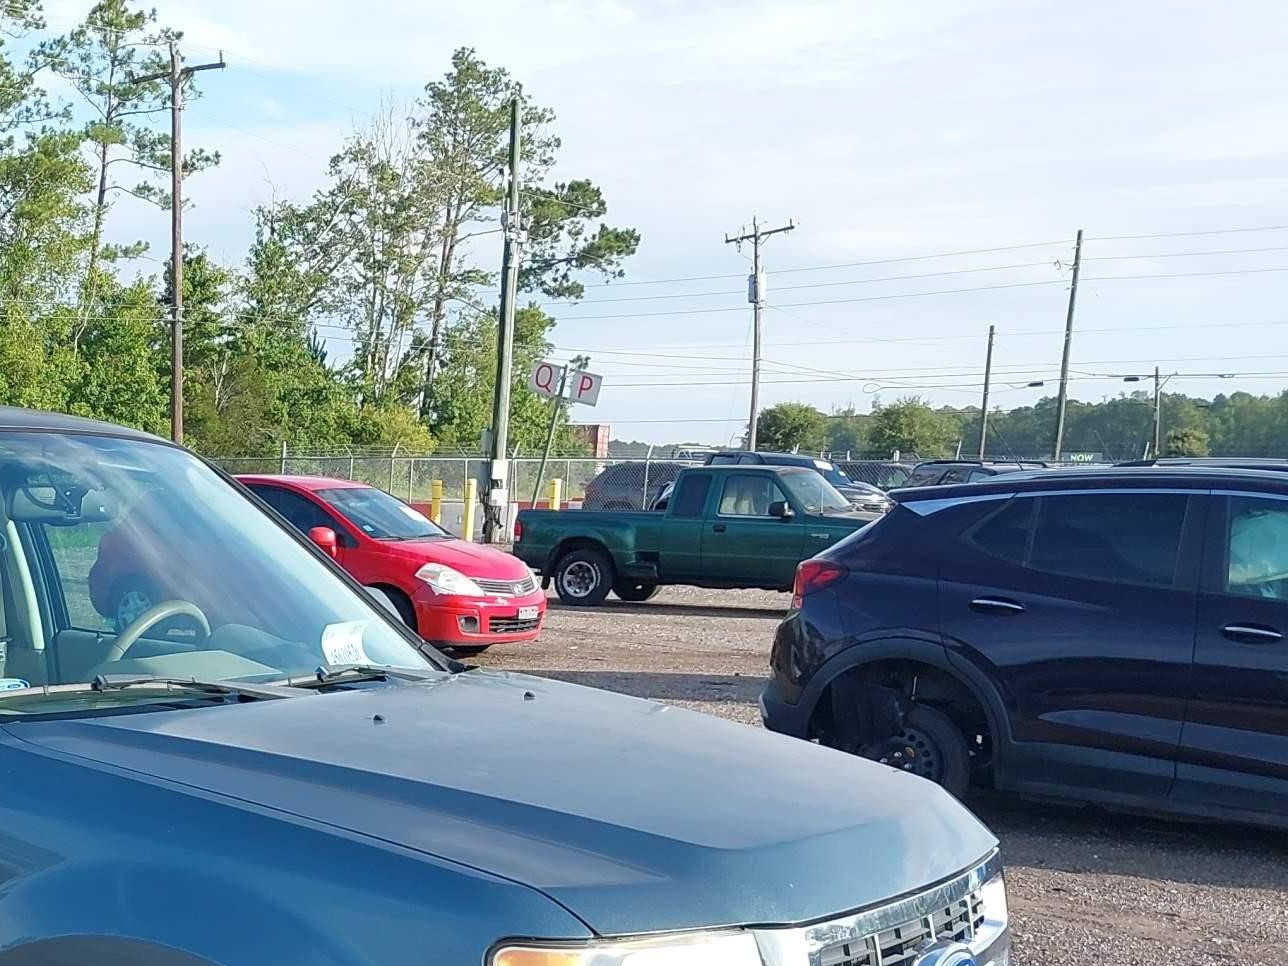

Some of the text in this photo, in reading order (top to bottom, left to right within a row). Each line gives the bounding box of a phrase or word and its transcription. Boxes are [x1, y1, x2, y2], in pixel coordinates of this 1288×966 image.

[535, 363, 553, 393] Q
[577, 374, 593, 399] P
[1070, 453, 1094, 462] NOW
